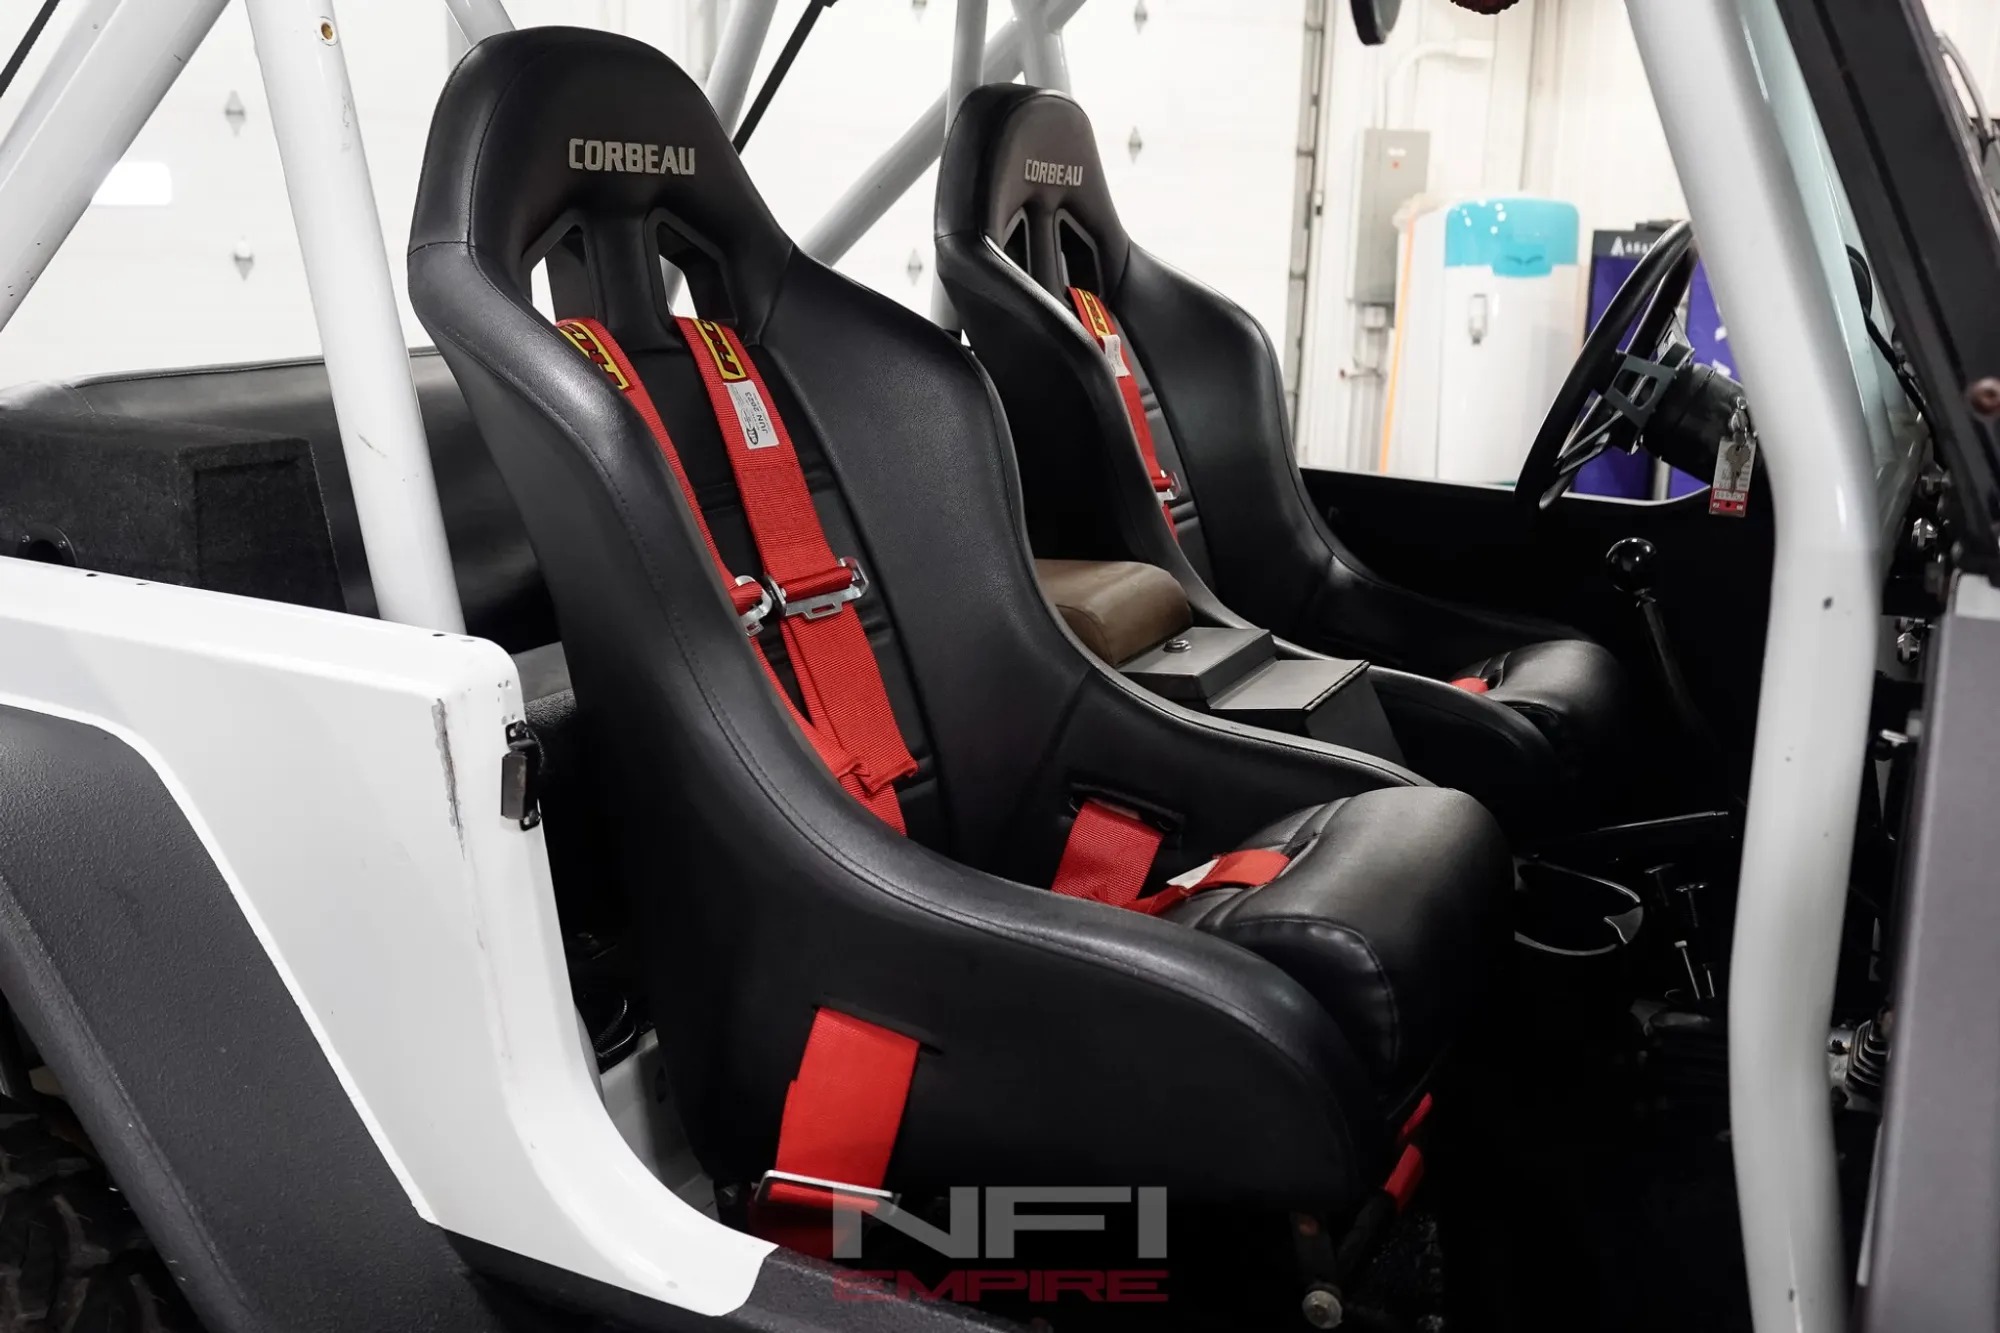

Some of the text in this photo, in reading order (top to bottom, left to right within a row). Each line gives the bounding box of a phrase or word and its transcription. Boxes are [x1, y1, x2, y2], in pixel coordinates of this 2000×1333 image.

[568, 138, 696, 175] CORBEAU
[1024, 159, 1083, 187] CORBEAU
[757, 414, 769, 434] JUN
